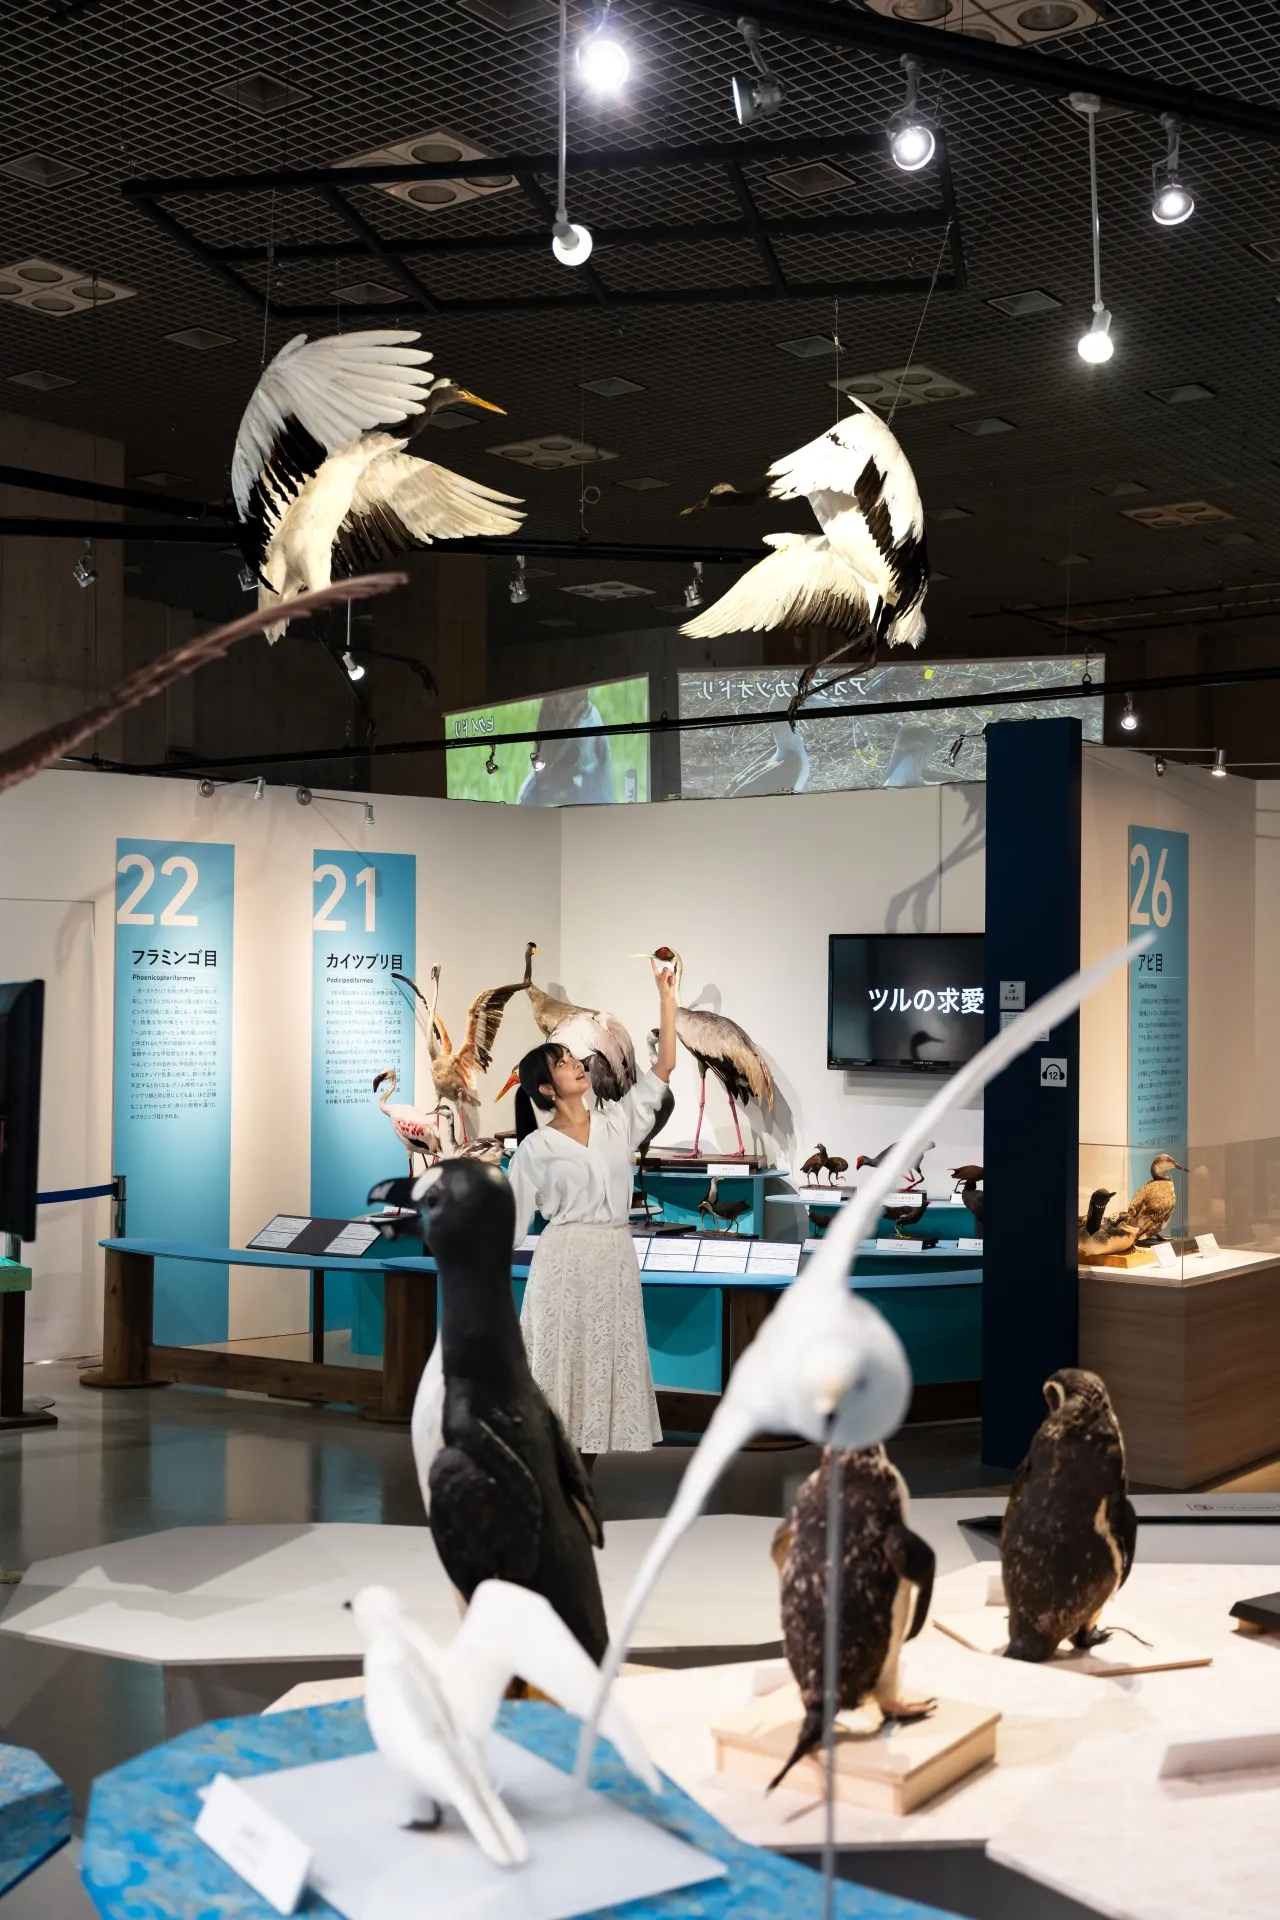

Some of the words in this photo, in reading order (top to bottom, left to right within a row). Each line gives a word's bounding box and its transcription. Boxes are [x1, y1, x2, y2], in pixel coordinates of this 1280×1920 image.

[116, 853, 199, 927] 22
[1130, 843, 1173, 928] 26
[313, 863, 376, 932] 21
[132, 949, 218, 968] フラミンゴ目
[326, 952, 403, 971] カイツブリ目
[1138, 953, 1164, 973] アビ目
[132, 974, 196, 982] Phoenicopteriformes
[326, 976, 374, 984] Podicipediformes
[868, 987, 984, 1014] ツルの求愛
[1048, 1071, 1058, 1080] 12
